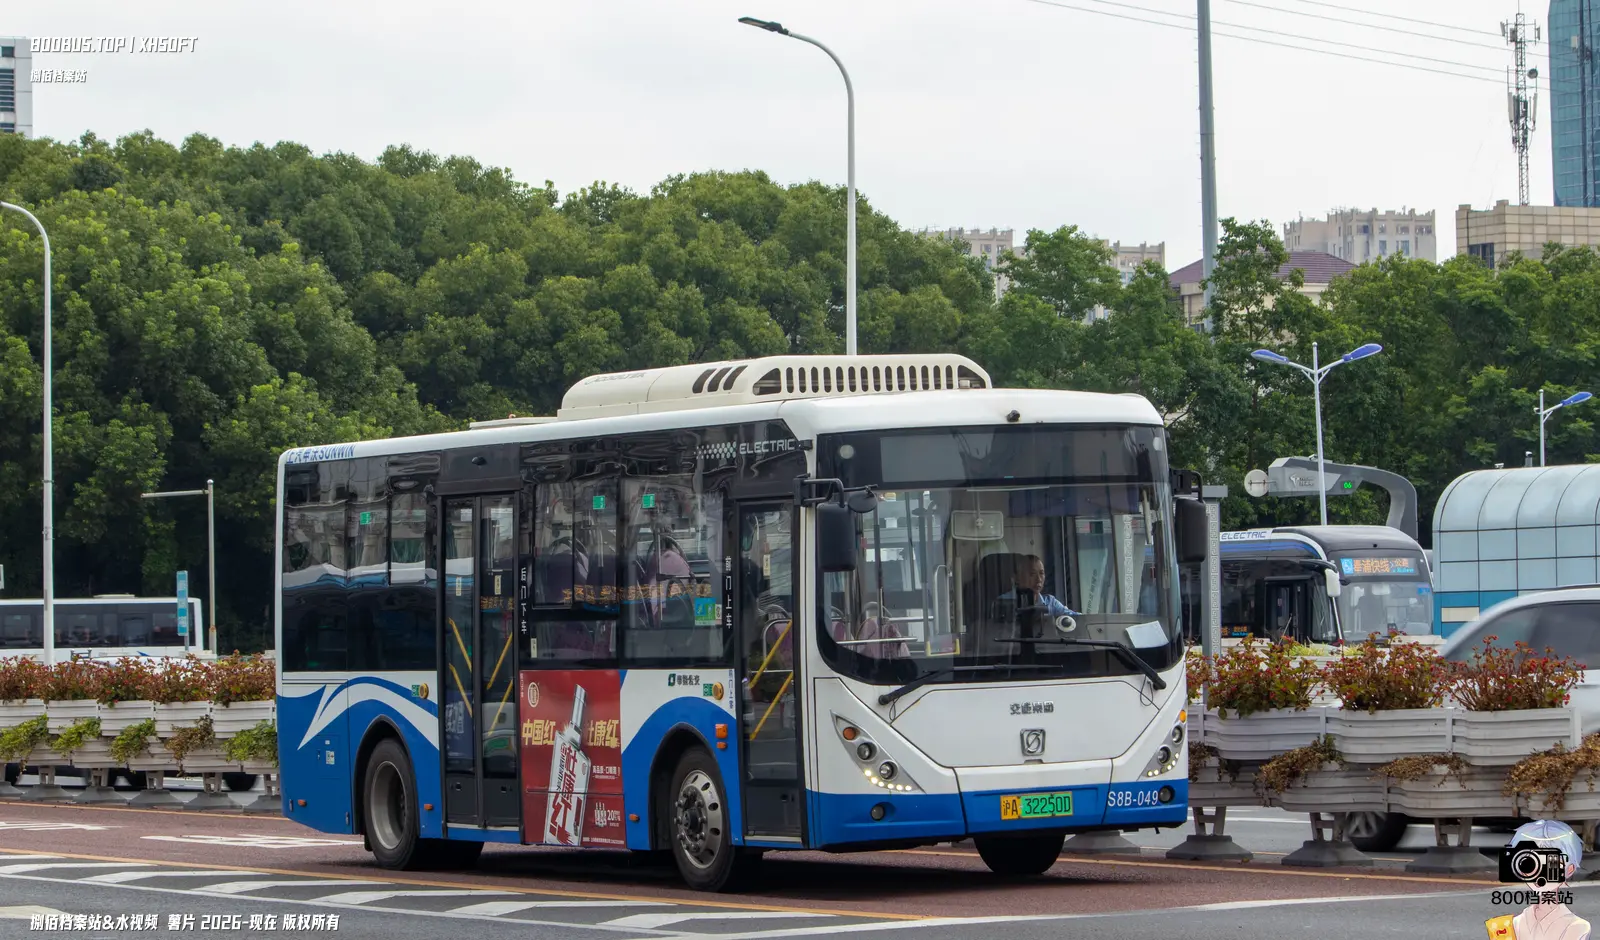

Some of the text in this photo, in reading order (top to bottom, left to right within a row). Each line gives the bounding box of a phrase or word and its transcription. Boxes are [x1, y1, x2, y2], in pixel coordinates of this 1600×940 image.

[740, 439, 795, 454] ELECTRIC
[1343, 481, 1352, 489] 06
[1221, 531, 1267, 540] ELECTRIC
[521, 719, 556, 746] 中国红
[1025, 796, 1071, 815] 32250D
[1107, 790, 1159, 807] S8B-049
